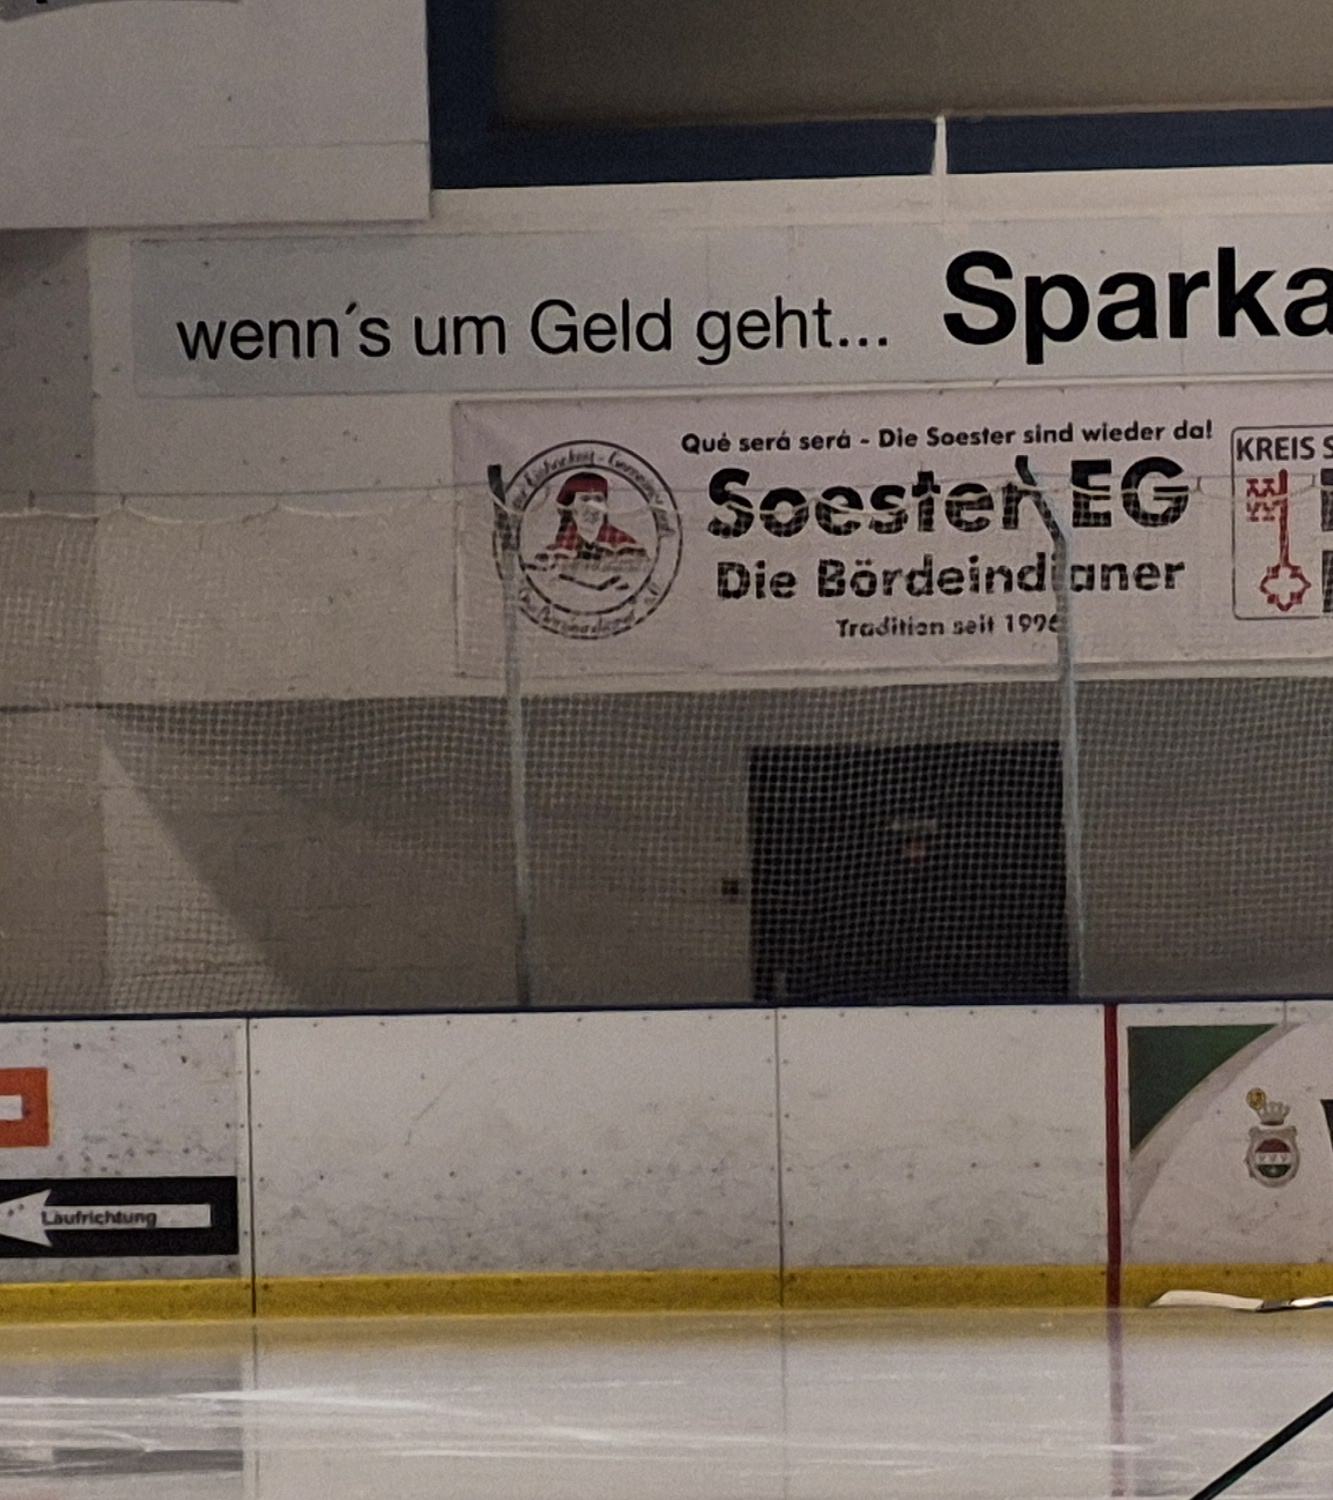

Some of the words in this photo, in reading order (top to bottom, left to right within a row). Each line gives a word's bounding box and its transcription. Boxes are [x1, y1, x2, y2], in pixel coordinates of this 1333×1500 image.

[413, 315, 506, 356] um
[530, 297, 671, 354] Geld
[696, 295, 889, 365] geht...
[680, 430, 732, 453] Qué
[739, 426, 791, 452] será
[799, 424, 851, 450] será
[878, 425, 919, 448] Die
[925, 420, 1014, 448] Soester
[1022, 419, 1073, 444] sind
[1081, 418, 1165, 443] wieder
[1172, 418, 1213, 441] da!
[1236, 436, 1316, 462] KREIS
[707, 462, 1037, 538] Soester
[1070, 455, 1189, 529] EG
[715, 559, 797, 599] Die
[835, 615, 942, 637] Tradition
[953, 612, 995, 636] seit
[41, 1211, 157, 1229] Laufrichtung
